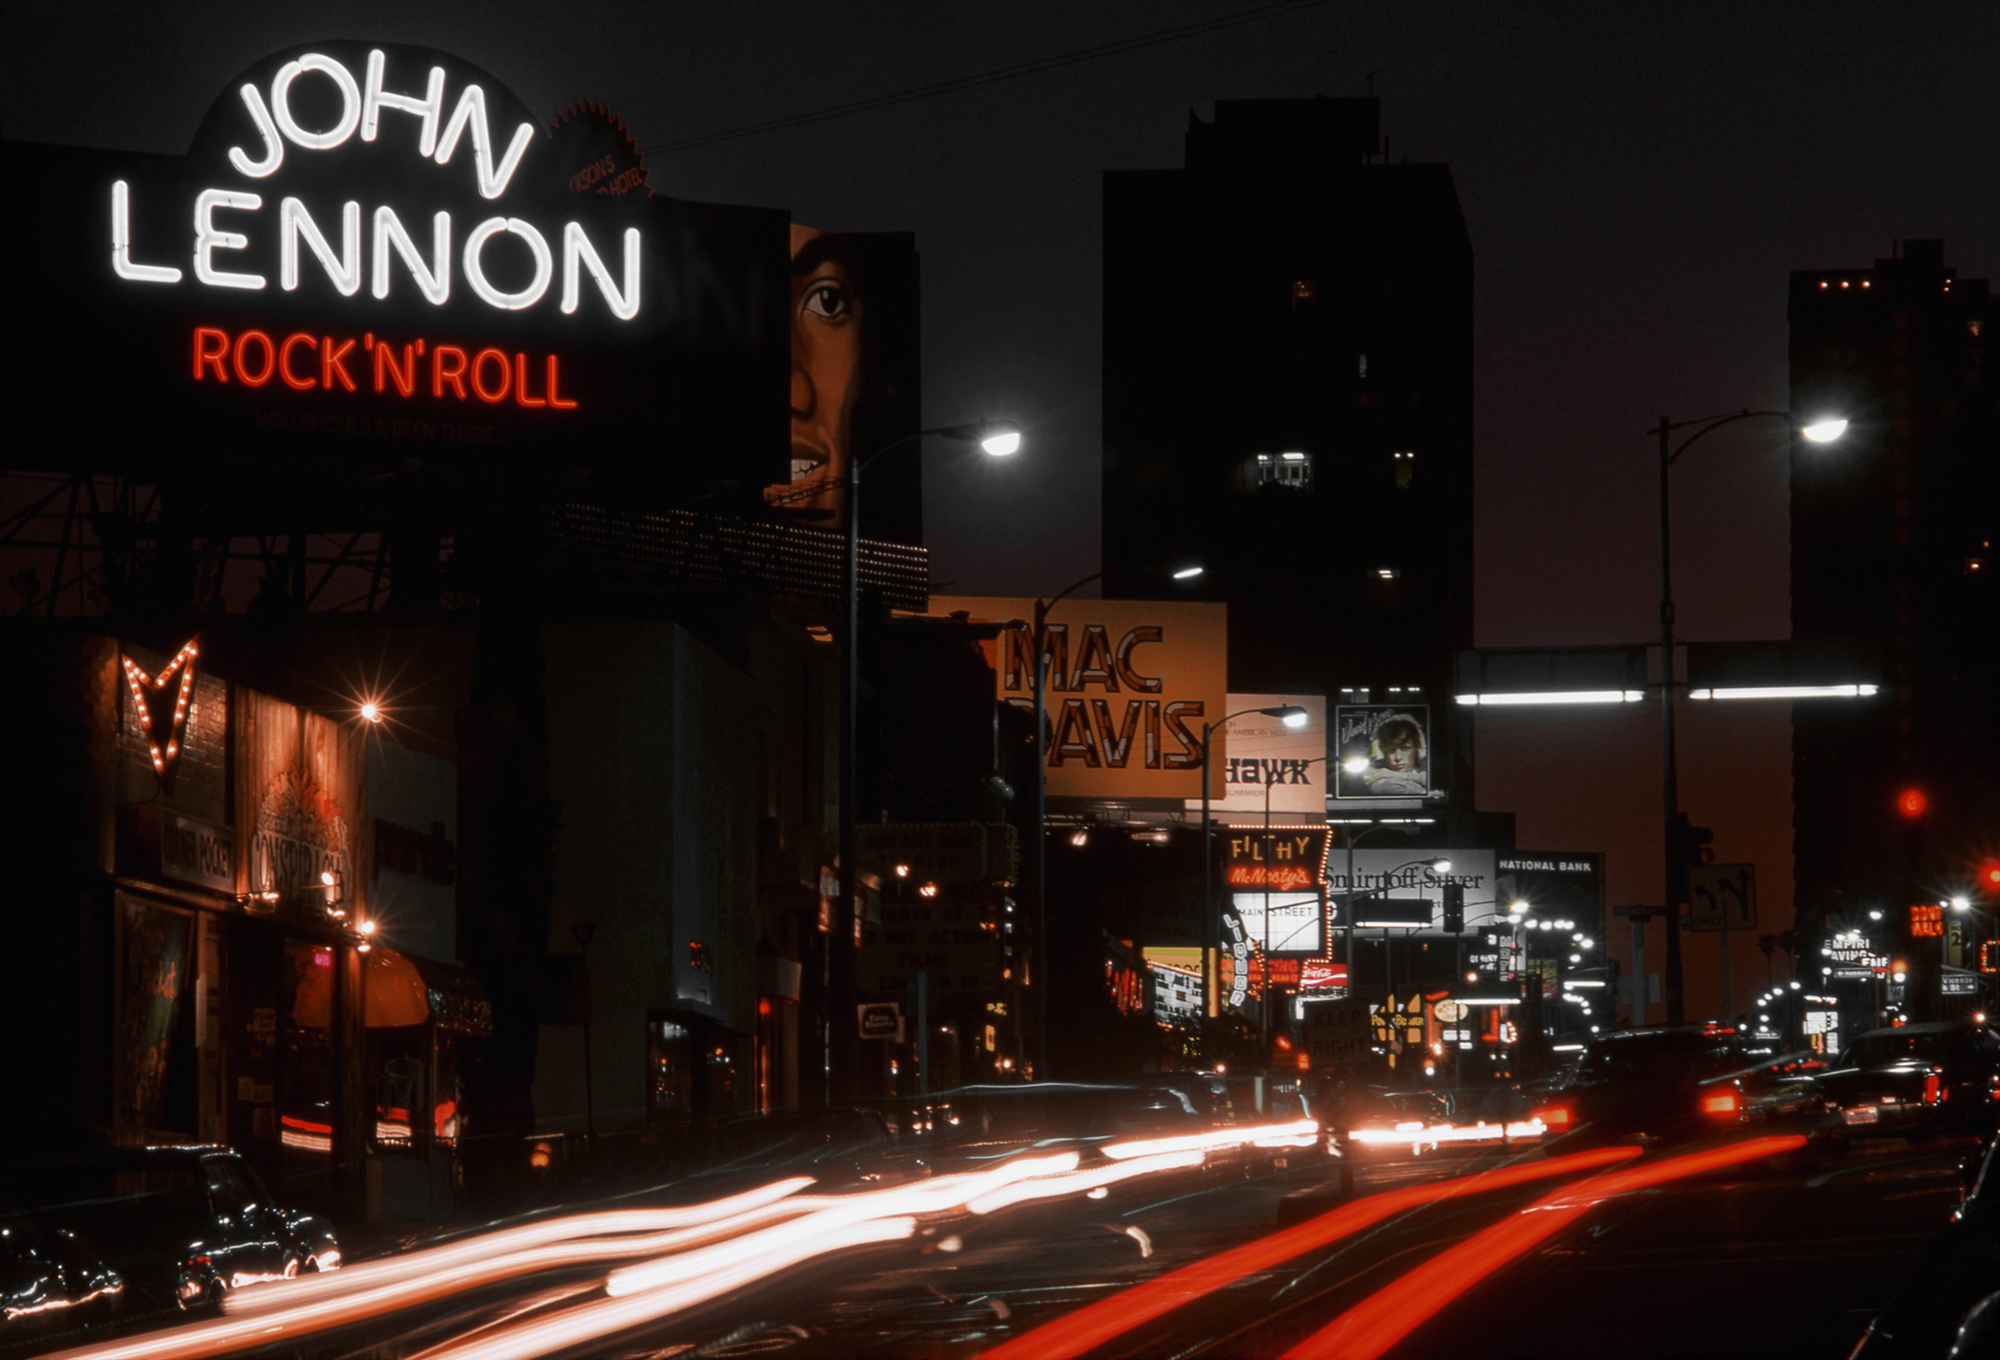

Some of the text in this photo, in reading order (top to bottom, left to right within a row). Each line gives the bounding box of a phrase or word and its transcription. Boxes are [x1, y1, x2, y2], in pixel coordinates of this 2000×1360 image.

[228, 49, 534, 200] JOHN
[609, 166, 643, 195] HOTEL
[112, 180, 640, 320] LENNON
[193, 327, 578, 409] ROCK'N'ROLL
[254, 410, 297, 431] YOU
[391, 419, 436, 443] BEEN
[1004, 624, 1163, 693] MAC
[1499, 860, 1592, 872] NATIONAL BANK
[941, 906, 963, 921] AT
[1238, 907, 1313, 917] MAIN STREET
[1693, 915, 1725, 927] ONLY
[927, 930, 989, 945] ACTION
[899, 953, 948, 968] FILMS
[1314, 1008, 1362, 1028] KEEP
[1313, 1037, 1366, 1057] RIGHT
